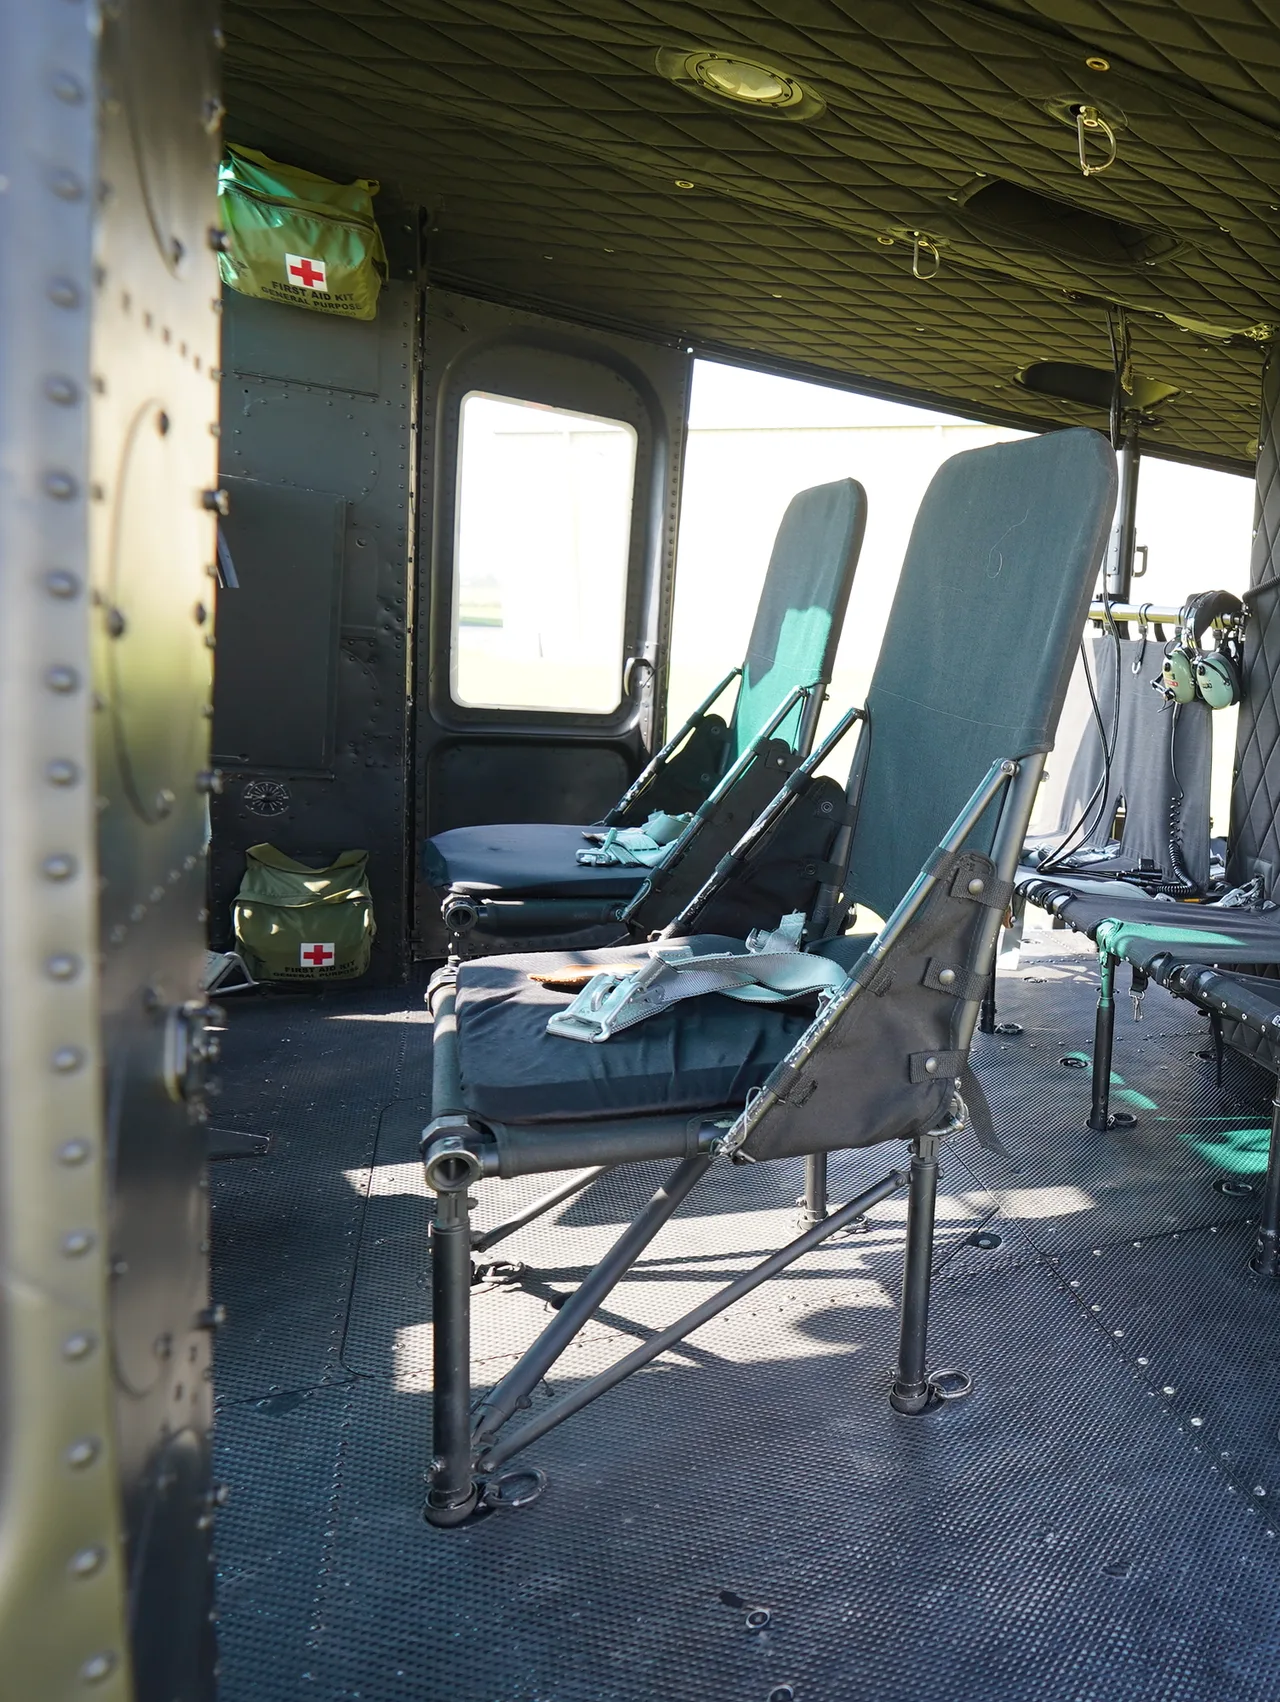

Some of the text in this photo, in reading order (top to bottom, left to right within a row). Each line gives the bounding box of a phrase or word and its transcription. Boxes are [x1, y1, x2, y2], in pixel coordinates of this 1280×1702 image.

[261, 286, 310, 305] GENERAL
[313, 300, 362, 310] PURPOSE
[272, 281, 354, 301] FIRST AID KIT
[319, 966, 359, 977] PURPOSE
[340, 960, 355, 970] KIT
